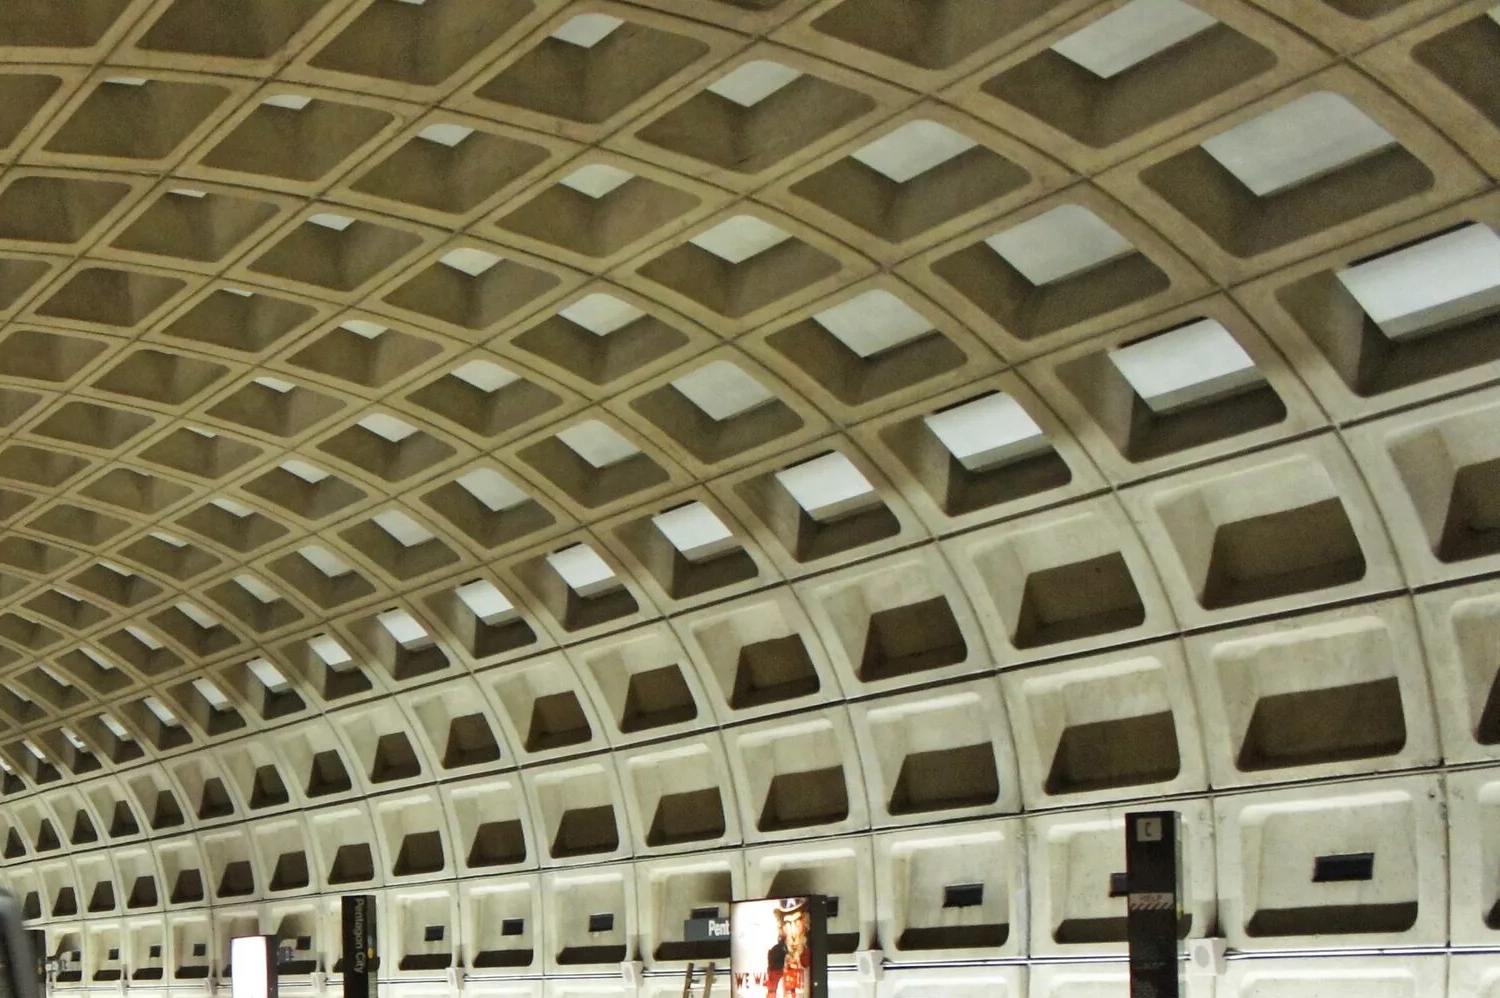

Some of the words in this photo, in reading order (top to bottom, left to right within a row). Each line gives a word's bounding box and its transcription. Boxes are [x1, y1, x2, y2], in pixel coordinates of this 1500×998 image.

[352, 898, 365, 949] Pentagon
[353, 951, 366, 973] City
[735, 972, 750, 989] WE
